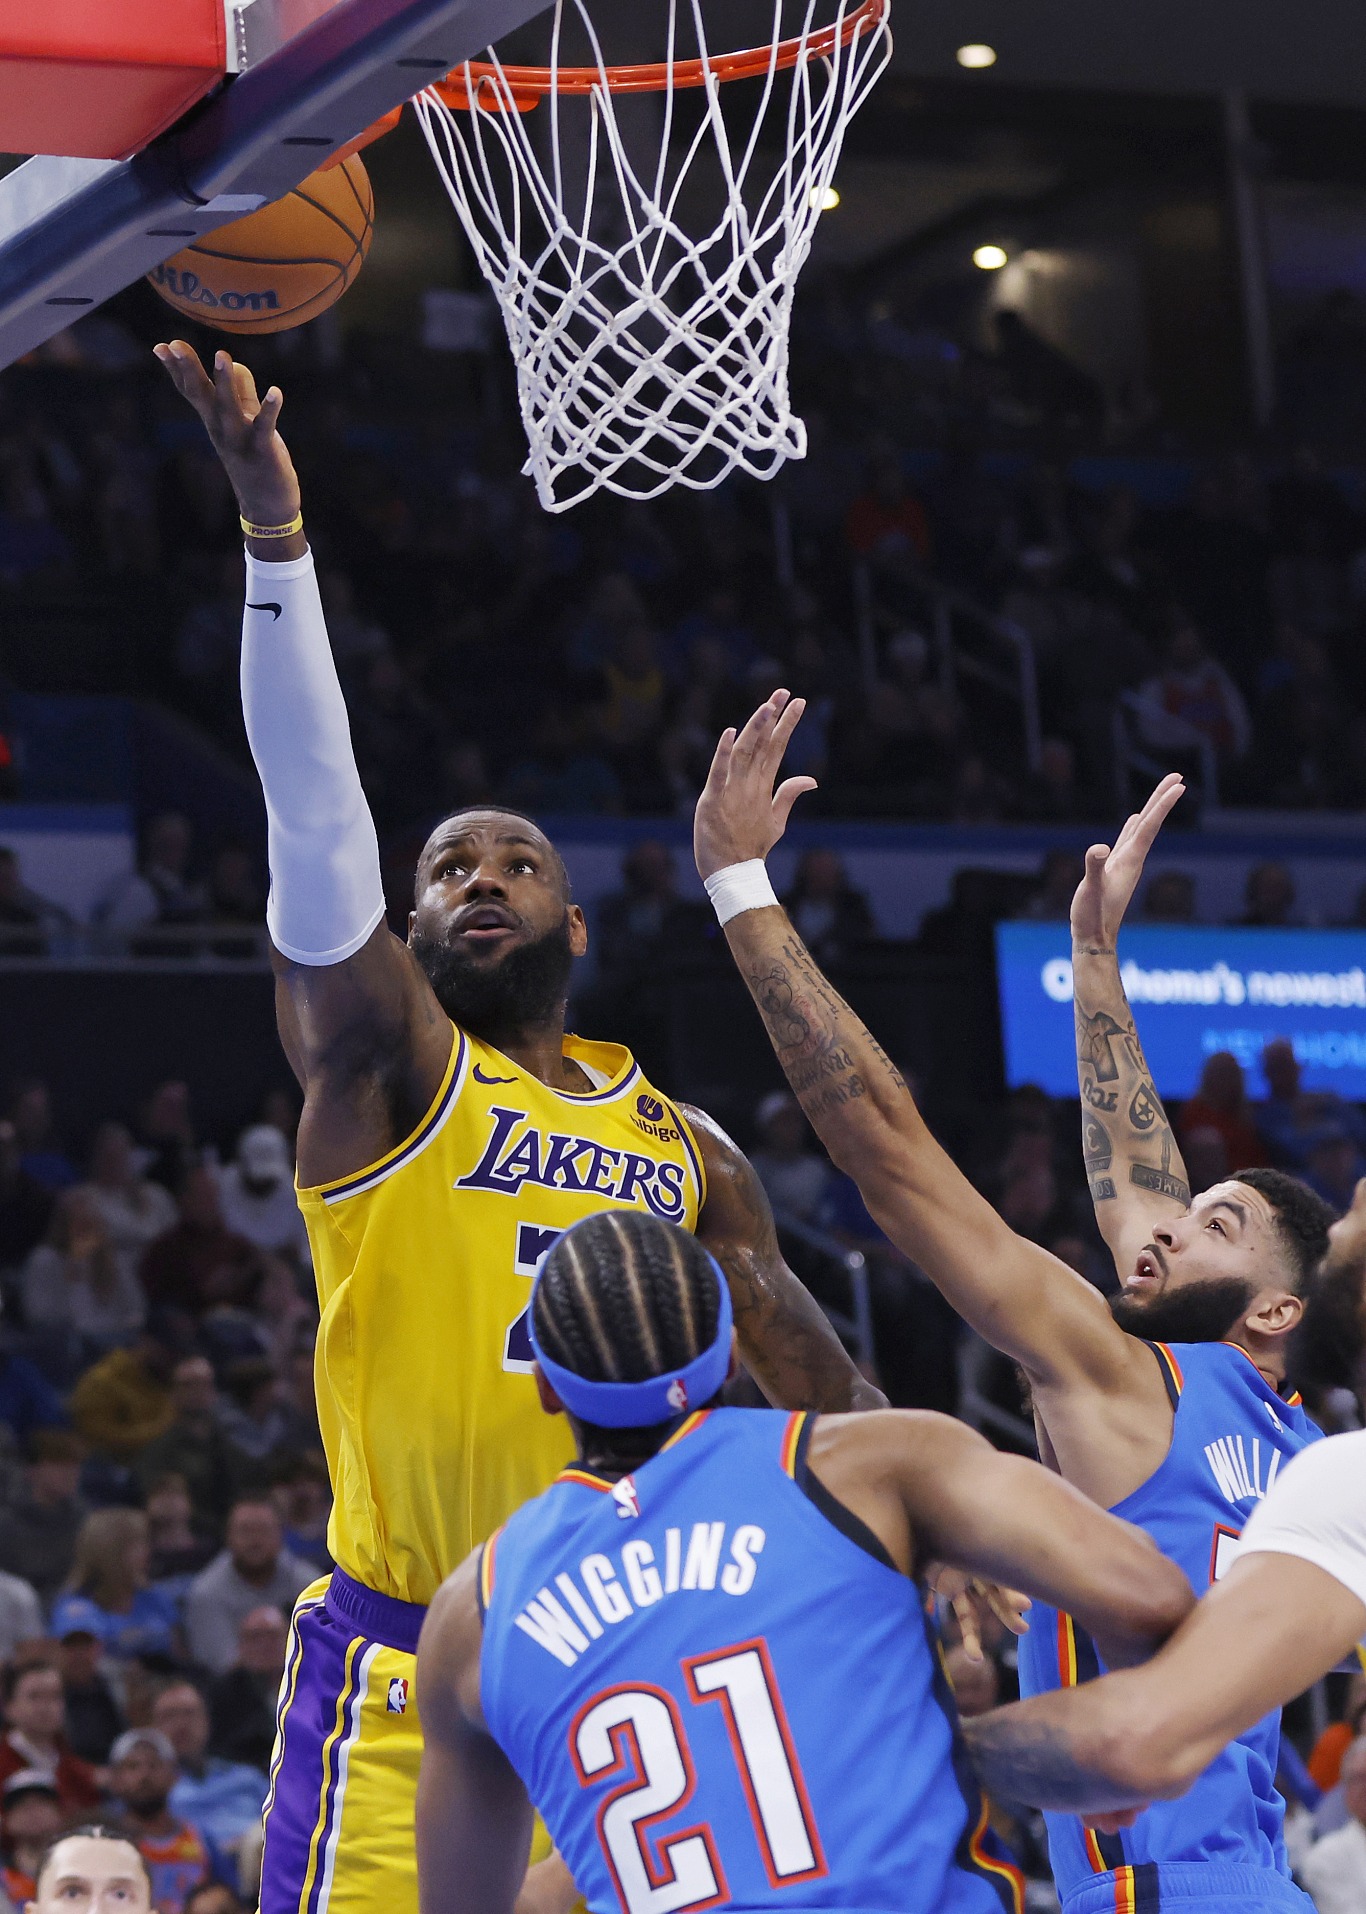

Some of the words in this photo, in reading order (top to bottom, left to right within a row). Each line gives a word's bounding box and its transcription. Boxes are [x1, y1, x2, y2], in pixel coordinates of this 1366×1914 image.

[252, 526, 292, 535] PROMISE
[452, 1104, 687, 1226] LAKERS
[1204, 1434, 1282, 1503] WILLI
[514, 1521, 767, 1668] WIGGINS
[568, 1636, 829, 1914] 21
